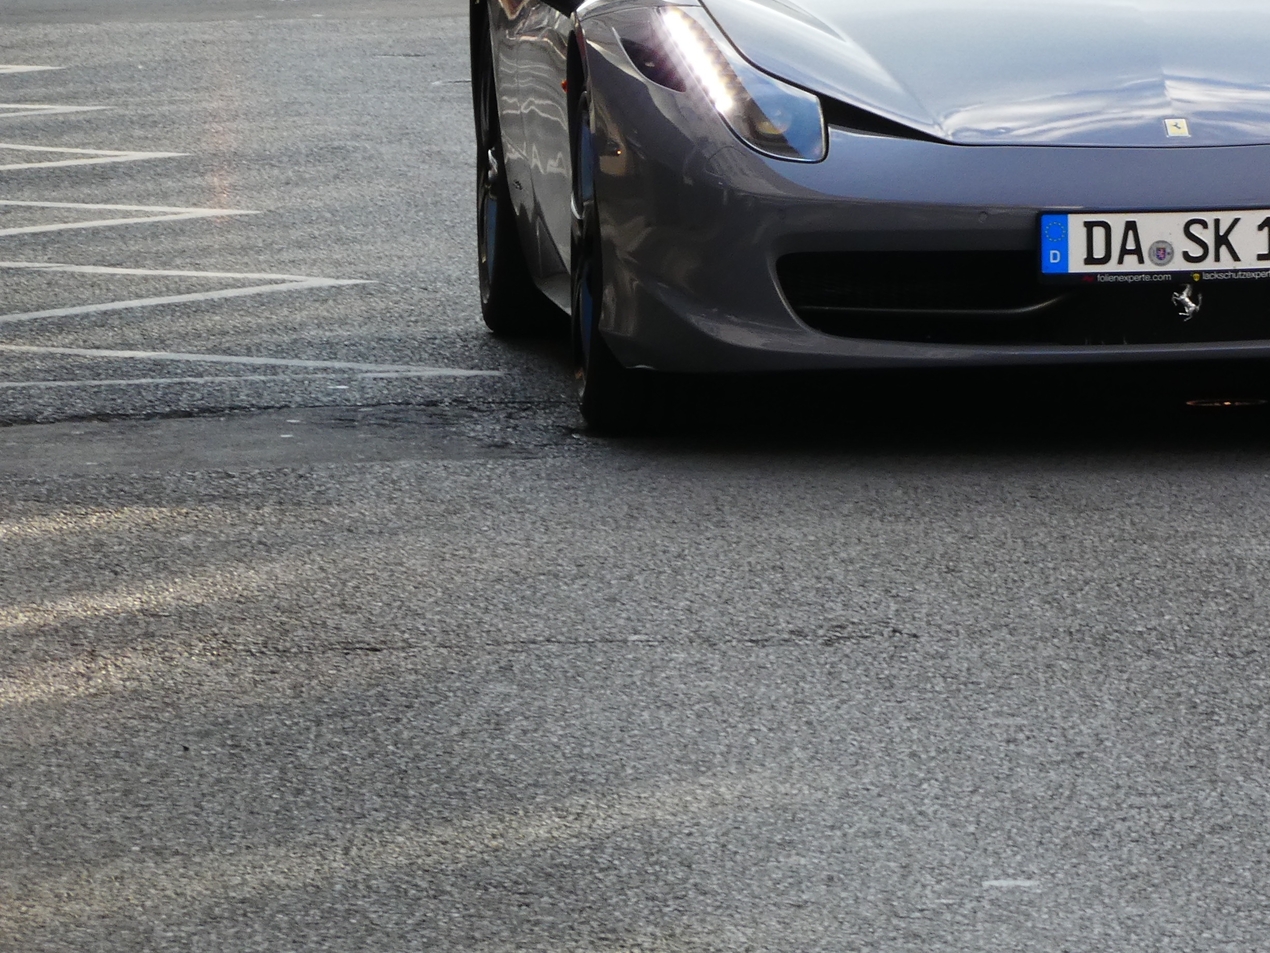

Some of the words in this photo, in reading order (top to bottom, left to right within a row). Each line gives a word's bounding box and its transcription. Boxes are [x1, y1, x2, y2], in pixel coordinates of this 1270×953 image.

[1050, 249, 1061, 264] D
[1083, 219, 1145, 265] DA
[1182, 217, 1242, 263] SK
[1097, 272, 1172, 283] folienexperte.com
